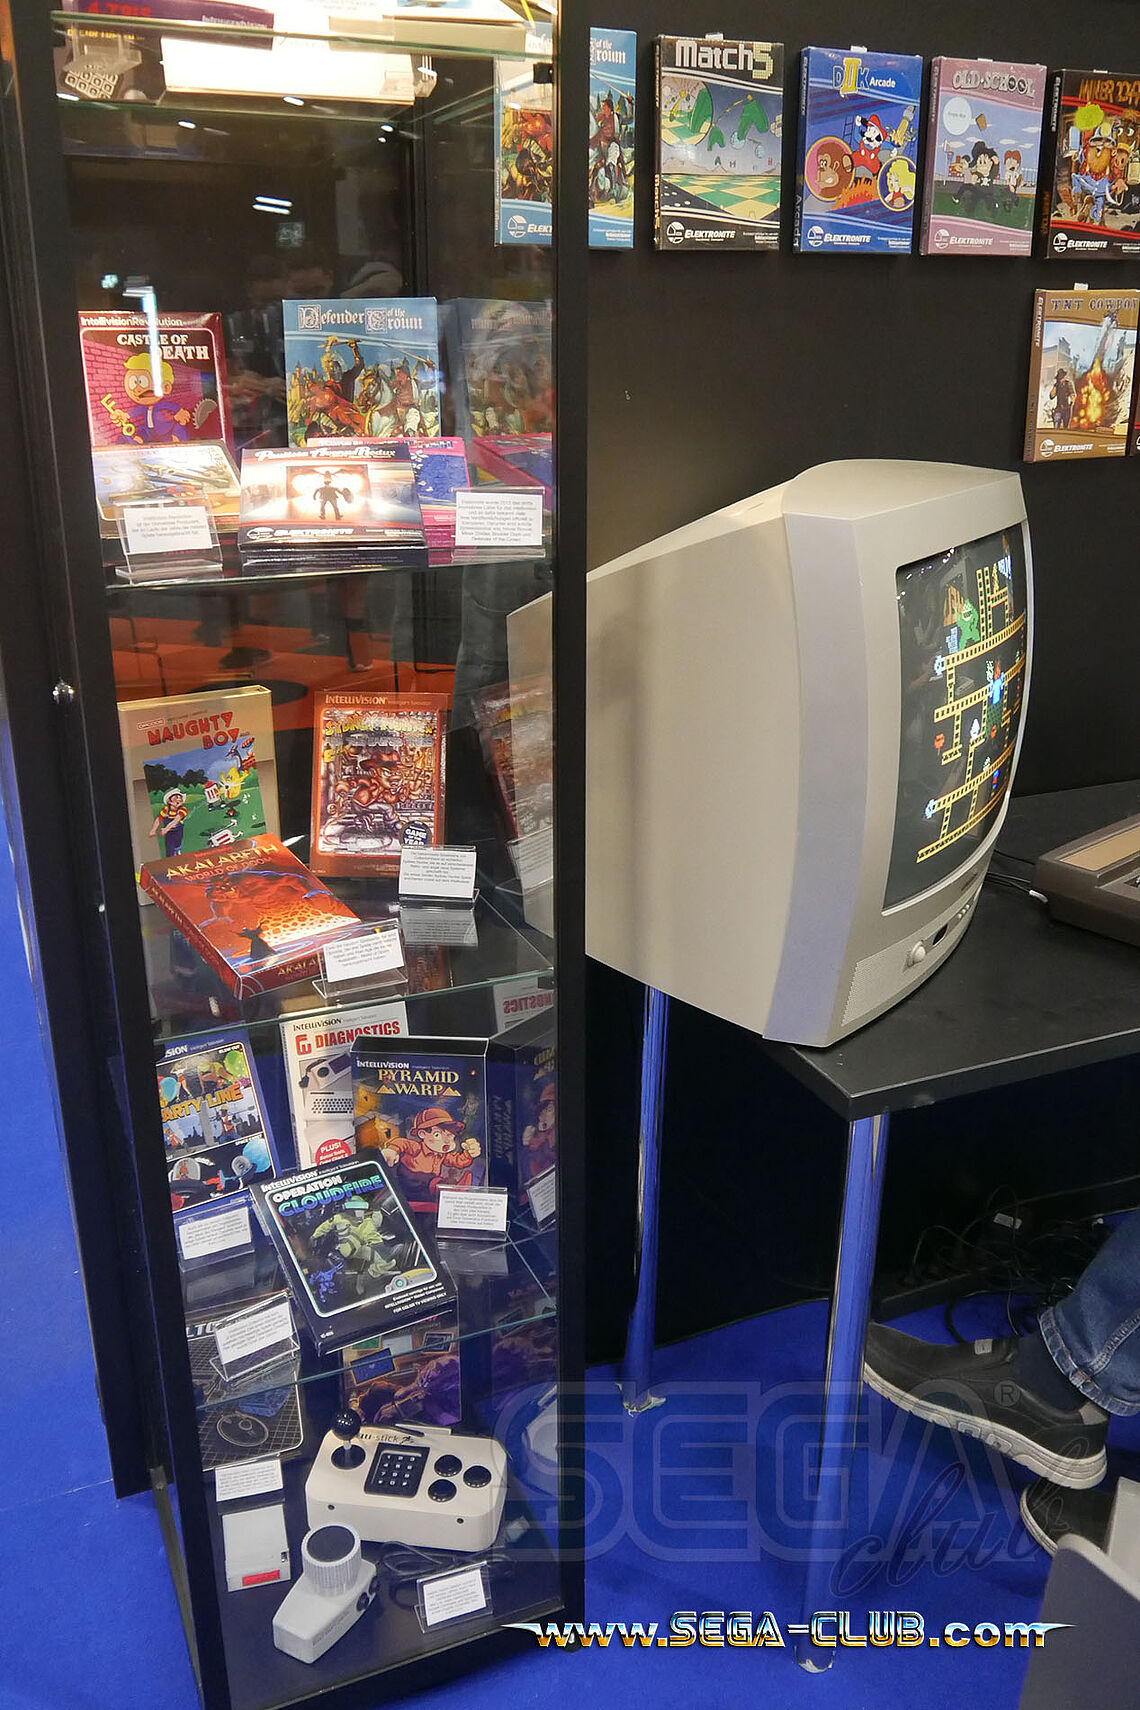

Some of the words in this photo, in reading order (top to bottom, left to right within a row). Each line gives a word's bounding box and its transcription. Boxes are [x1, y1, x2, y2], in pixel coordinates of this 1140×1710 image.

[869, 77, 896, 88] Arcade
[684, 229, 736, 239] ELEKTRONITE
[823, 233, 872, 243] ELEKTRONITE
[949, 236, 994, 246] ELEKTRONITE
[1067, 240, 1108, 249] ELEKTRONITE
[1051, 299, 1084, 311] TNT
[298, 304, 364, 331] Defender
[116, 334, 169, 347] CASTE
[170, 334, 189, 346] OF
[147, 711, 234, 746] NAUGHTY
[202, 727, 240, 750] BOY
[405, 828, 427, 839] GAME
[293, 1018, 342, 1031] INTELLIVISION
[315, 1021, 401, 1049] DIAGNOSTICS
[356, 1059, 410, 1069] INTELLIVISION
[377, 1068, 460, 1084] PYRAMID
[205, 1084, 244, 1108] LINE
[395, 1083, 444, 1096] WARP
[260, 1170, 318, 1193] INTELLIVISION
[272, 1175, 343, 1203] OPERATION
[278, 1174, 385, 1217] CLOUDFIRE
